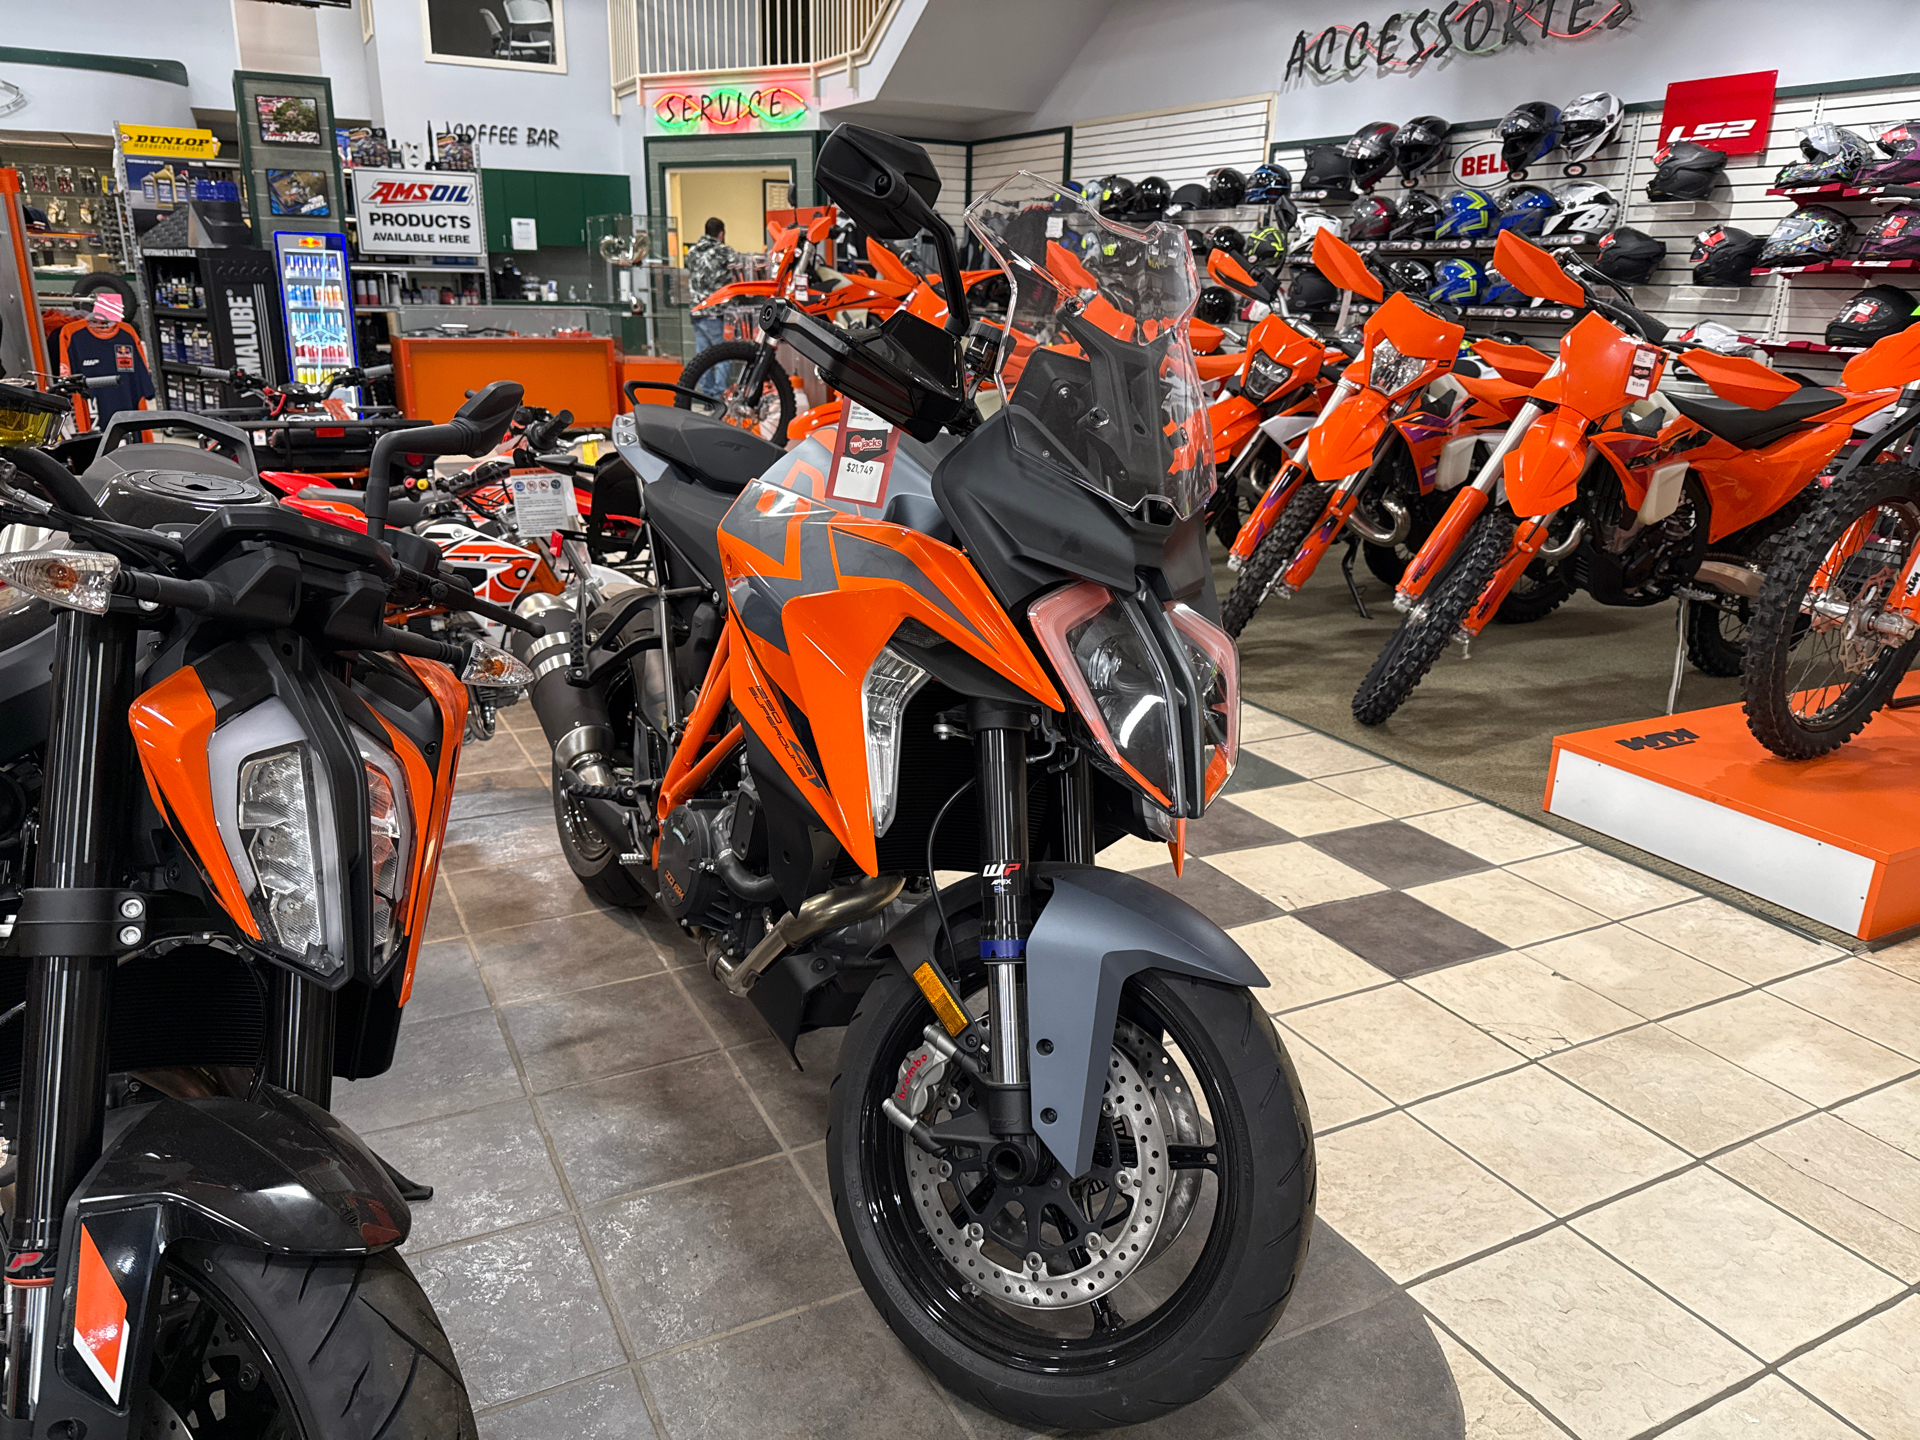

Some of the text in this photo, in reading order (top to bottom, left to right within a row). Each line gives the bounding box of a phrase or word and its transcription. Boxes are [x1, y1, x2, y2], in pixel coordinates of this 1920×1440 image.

[666, 88, 782, 123] SERVICE
[135, 134, 210, 147] DUNLOP
[526, 127, 560, 149] BAR
[1666, 119, 1757, 143] LS2
[133, 143, 180, 152] MOTORCYCLE
[369, 181, 470, 205] AMSOIL
[369, 212, 471, 229] PRODUCTS
[372, 232, 470, 244] AVAILABLE HERE
[846, 463, 873, 475] $21,749
[1614, 728, 1700, 751] KTM
[982, 863, 1022, 878] WP
[897, 1053, 928, 1101] brembo
